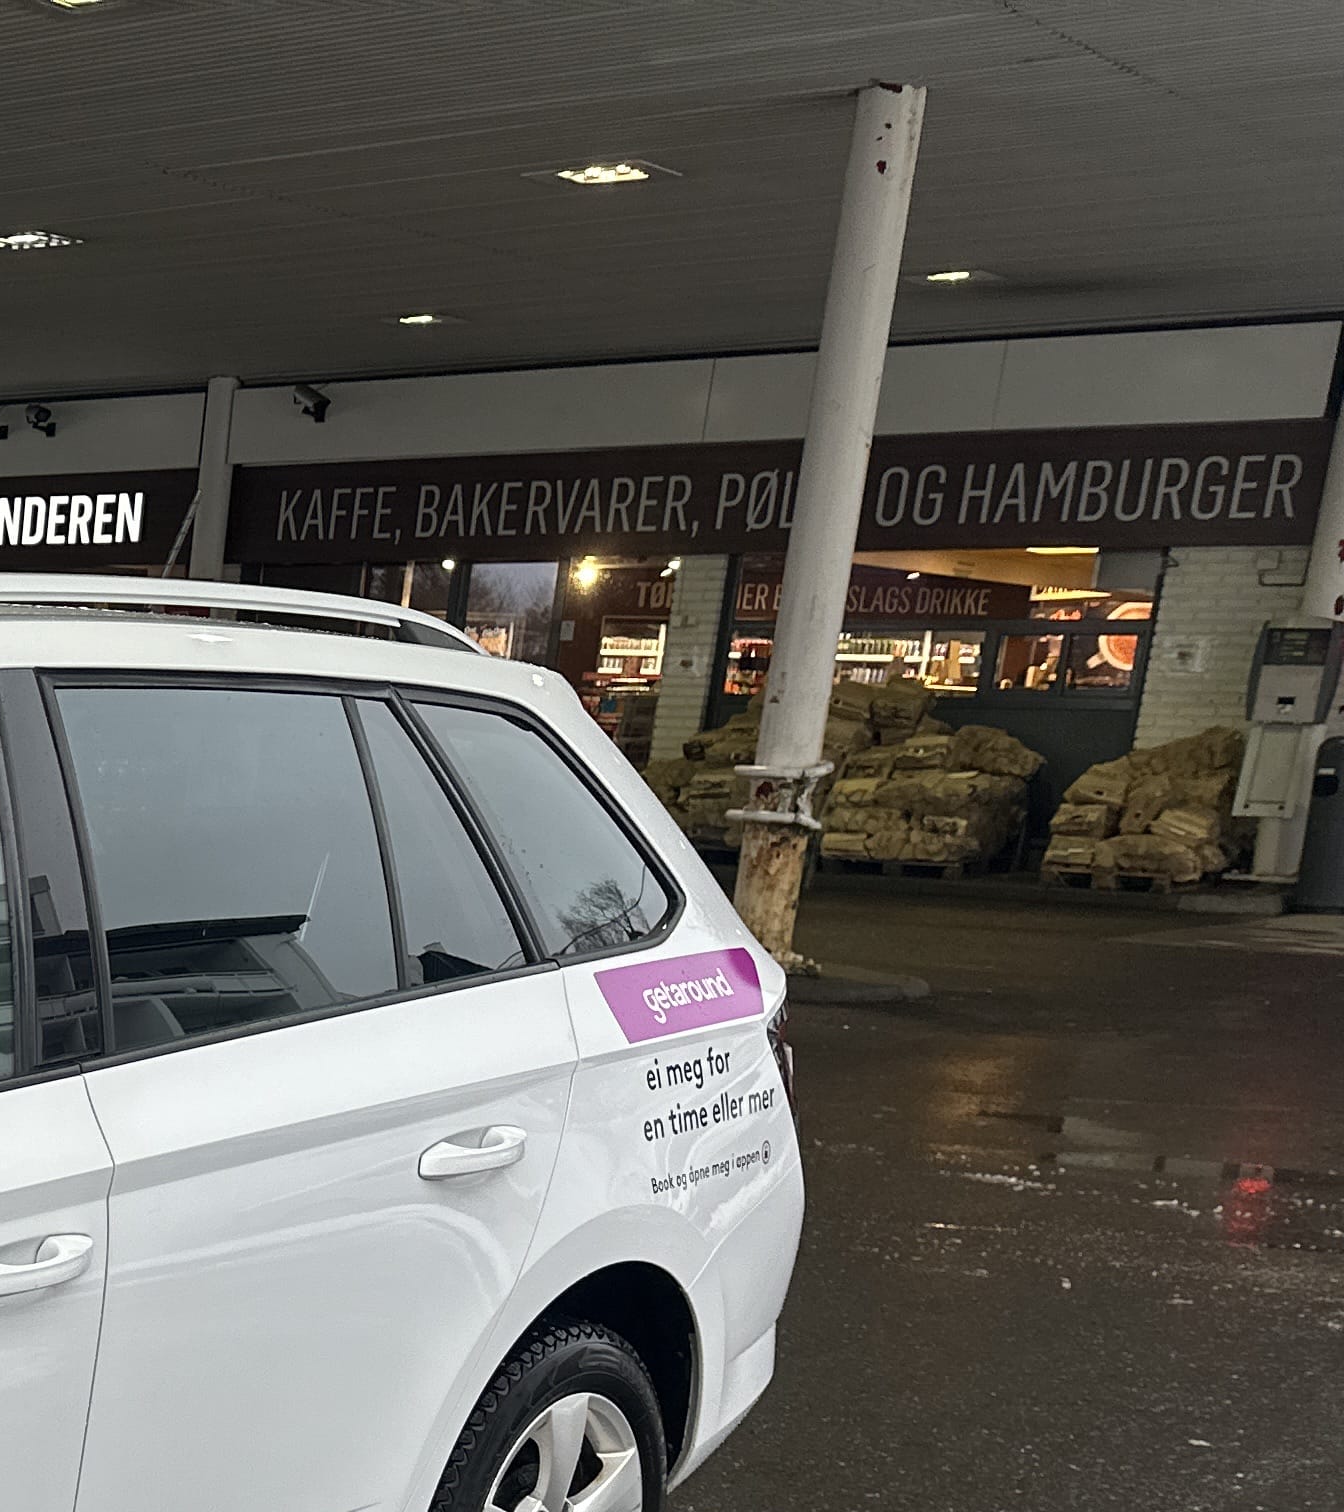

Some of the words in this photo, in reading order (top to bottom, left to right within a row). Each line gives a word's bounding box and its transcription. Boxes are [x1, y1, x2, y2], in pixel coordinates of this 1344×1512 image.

[276, 486, 402, 545] KAFFE,
[414, 474, 700, 538] BAKERVARER,
[715, 467, 797, 532] PØL
[874, 463, 947, 528] OG
[958, 453, 1303, 524] HAMBURGER
[845, 585, 912, 614] SLAGS
[914, 587, 992, 616] DRIKKE
[642, 967, 735, 1024] getaround
[646, 1058, 662, 1090] ei
[666, 1058, 704, 1089] meg
[706, 1046, 730, 1077] for
[643, 1116, 665, 1142] en
[668, 1103, 708, 1136] time
[712, 1091, 744, 1124] eller
[748, 1087, 775, 1115] mer
[650, 1173, 675, 1194] Book
[676, 1173, 688, 1191] og
[688, 1165, 710, 1187] åpne
[712, 1160, 730, 1177] meg
[736, 1149, 761, 1171] appen
